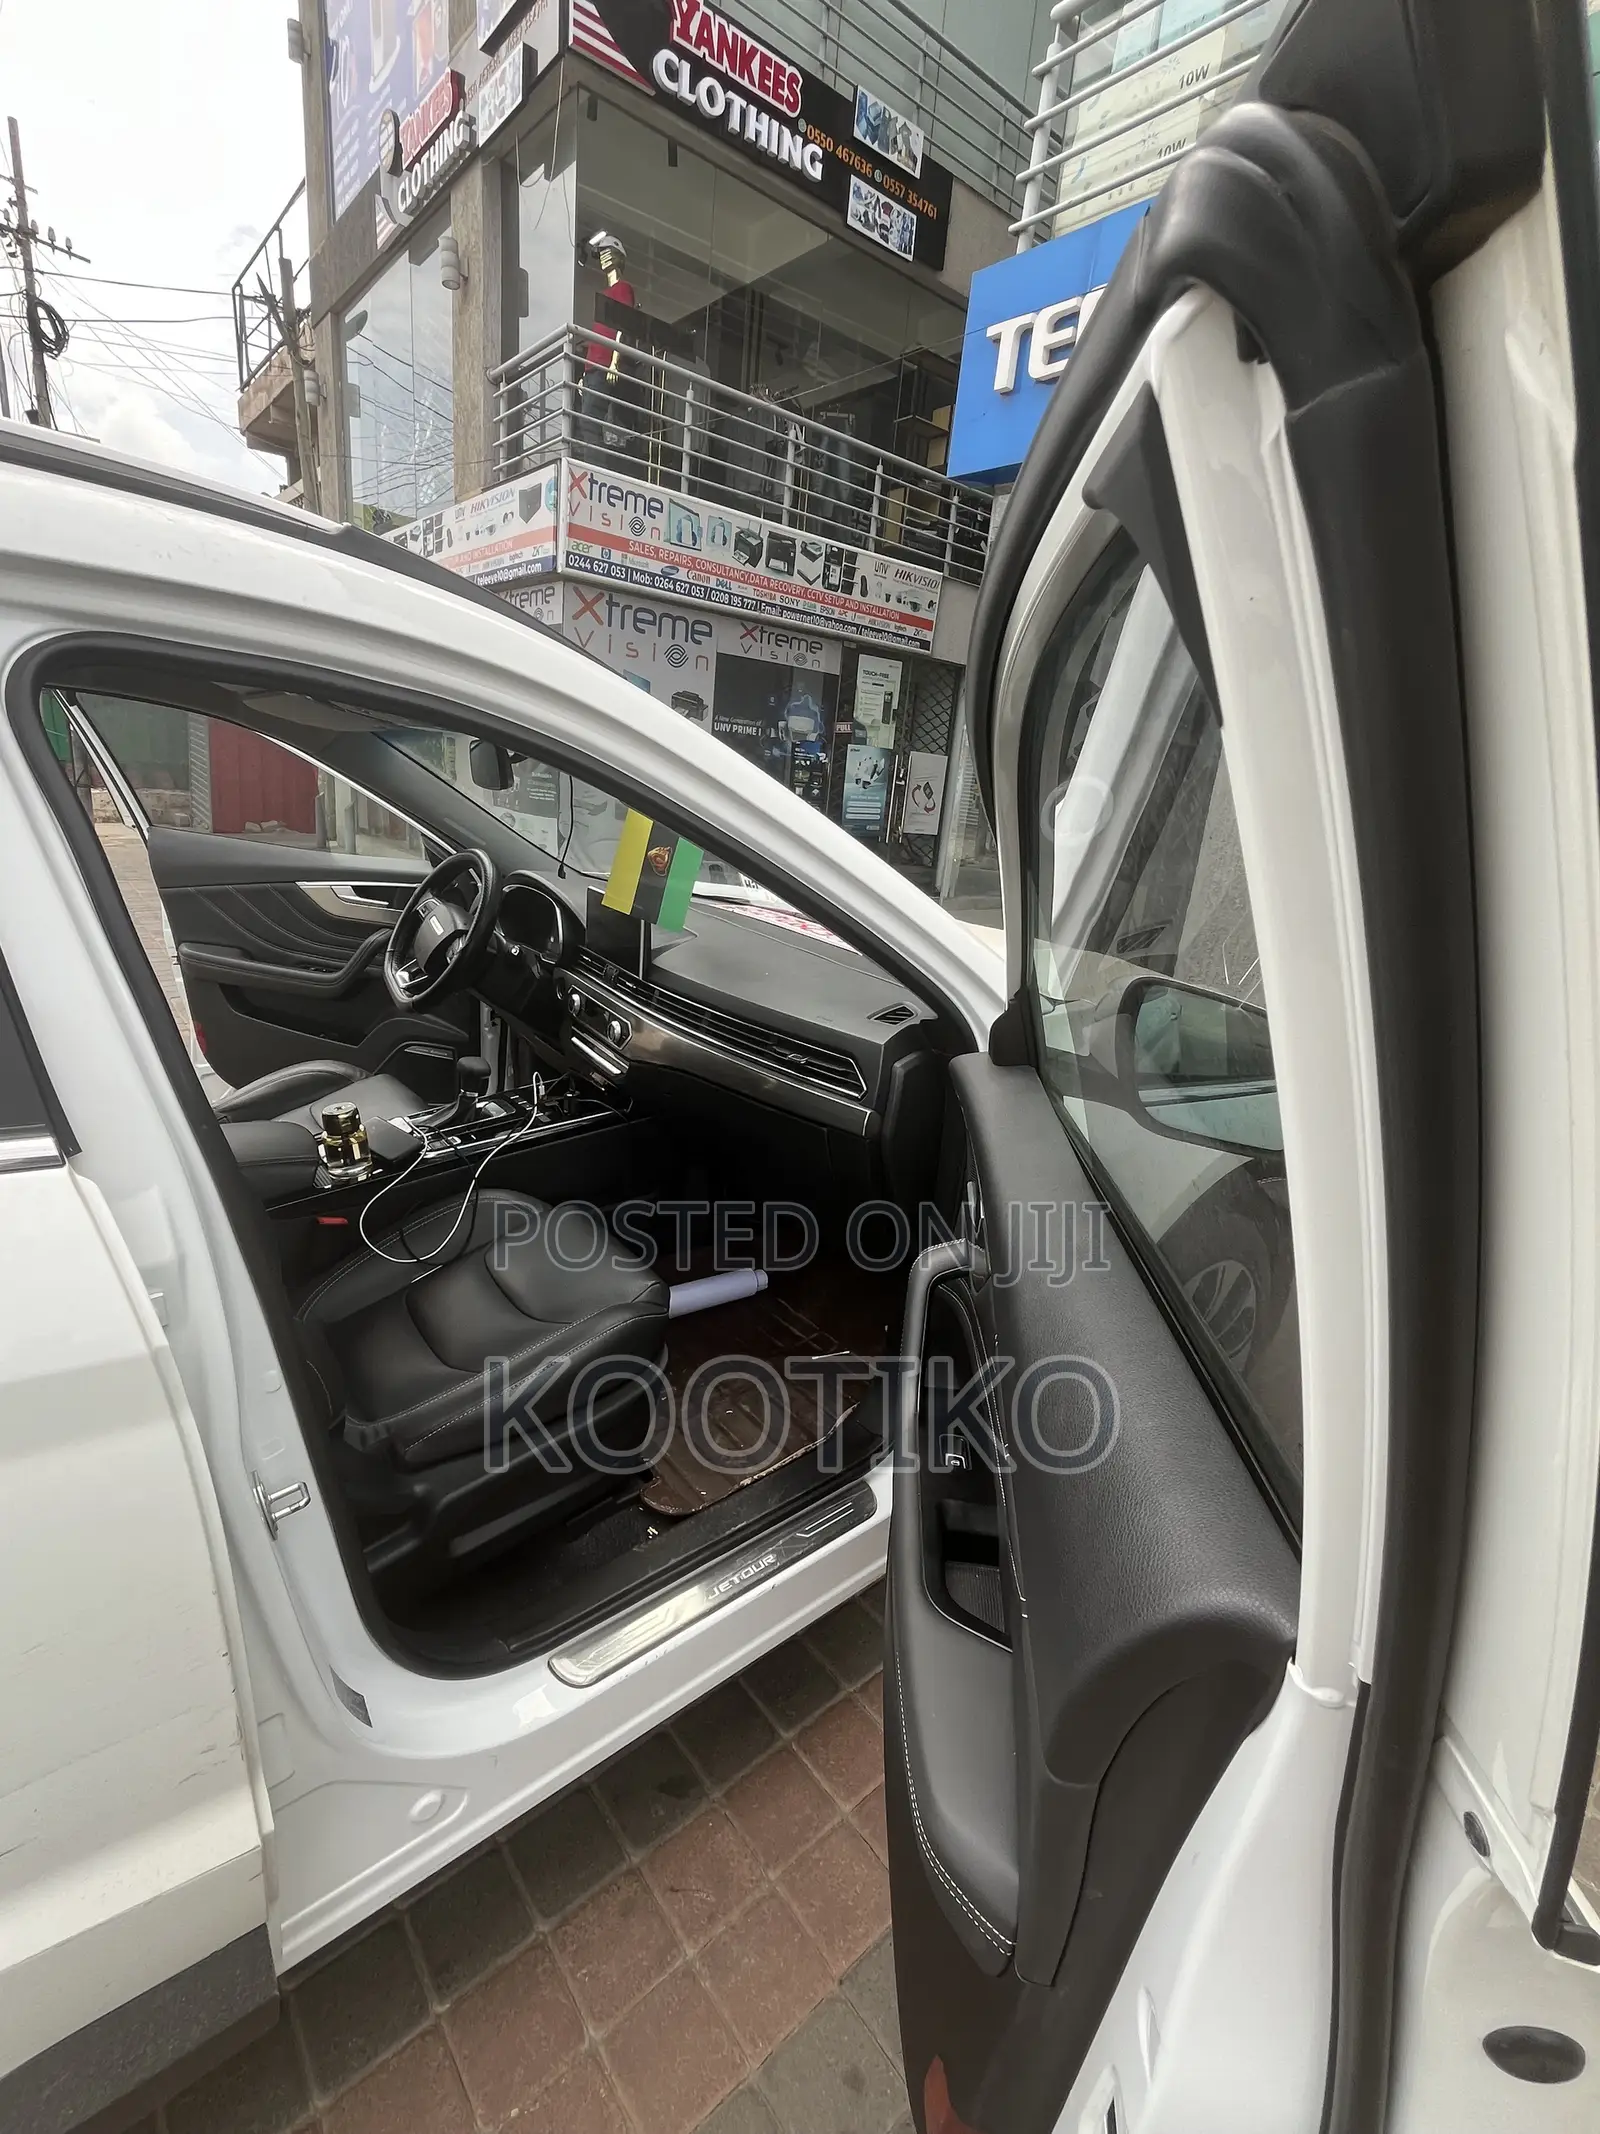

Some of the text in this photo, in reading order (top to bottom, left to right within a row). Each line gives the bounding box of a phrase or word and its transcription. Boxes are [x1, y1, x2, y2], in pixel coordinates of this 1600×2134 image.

[673, 0, 802, 118] YANKEES
[1179, 63, 1210, 89] 10W
[400, 67, 452, 170] YANKEES
[653, 49, 823, 182] CLOTHING
[398, 110, 469, 212] CLOTHING
[807, 124, 938, 219] 0550 467636 0557 354761
[470, 487, 516, 514] HIKVISION
[569, 467, 664, 519] Xtreme
[568, 555, 591, 573] 0244
[593, 561, 609, 574] 627
[610, 565, 626, 579] 053
[633, 570, 653, 586] Mob:
[654, 576, 674, 591] 0264
[675, 581, 689, 594] 627
[691, 586, 705, 598] 053
[711, 590, 729, 605] 0208
[731, 594, 742, 608] 195
[761, 603, 782, 615] Email:
[571, 541, 593, 553] acer
[687, 570, 711, 585] Canon
[753, 588, 777, 601] TOSHIBA
[779, 595, 800, 608] SONY
[628, 540, 657, 557] SALES,
[659, 548, 694, 568] REPAIRS,
[769, 579, 806, 598] RECOVERY,
[806, 588, 824, 602] CCTV
[824, 594, 845, 607] SETUP
[845, 600, 859, 610] AND
[860, 603, 900, 620] INSTALLATION
[572, 586, 713, 645] Xtreme
[740, 621, 823, 655] Xtreme
[714, 722, 731, 732] UNV
[732, 724, 758, 736] PRIME
[836, 723, 851, 731] PULL
[708, 1554, 777, 1600] JETOUR
